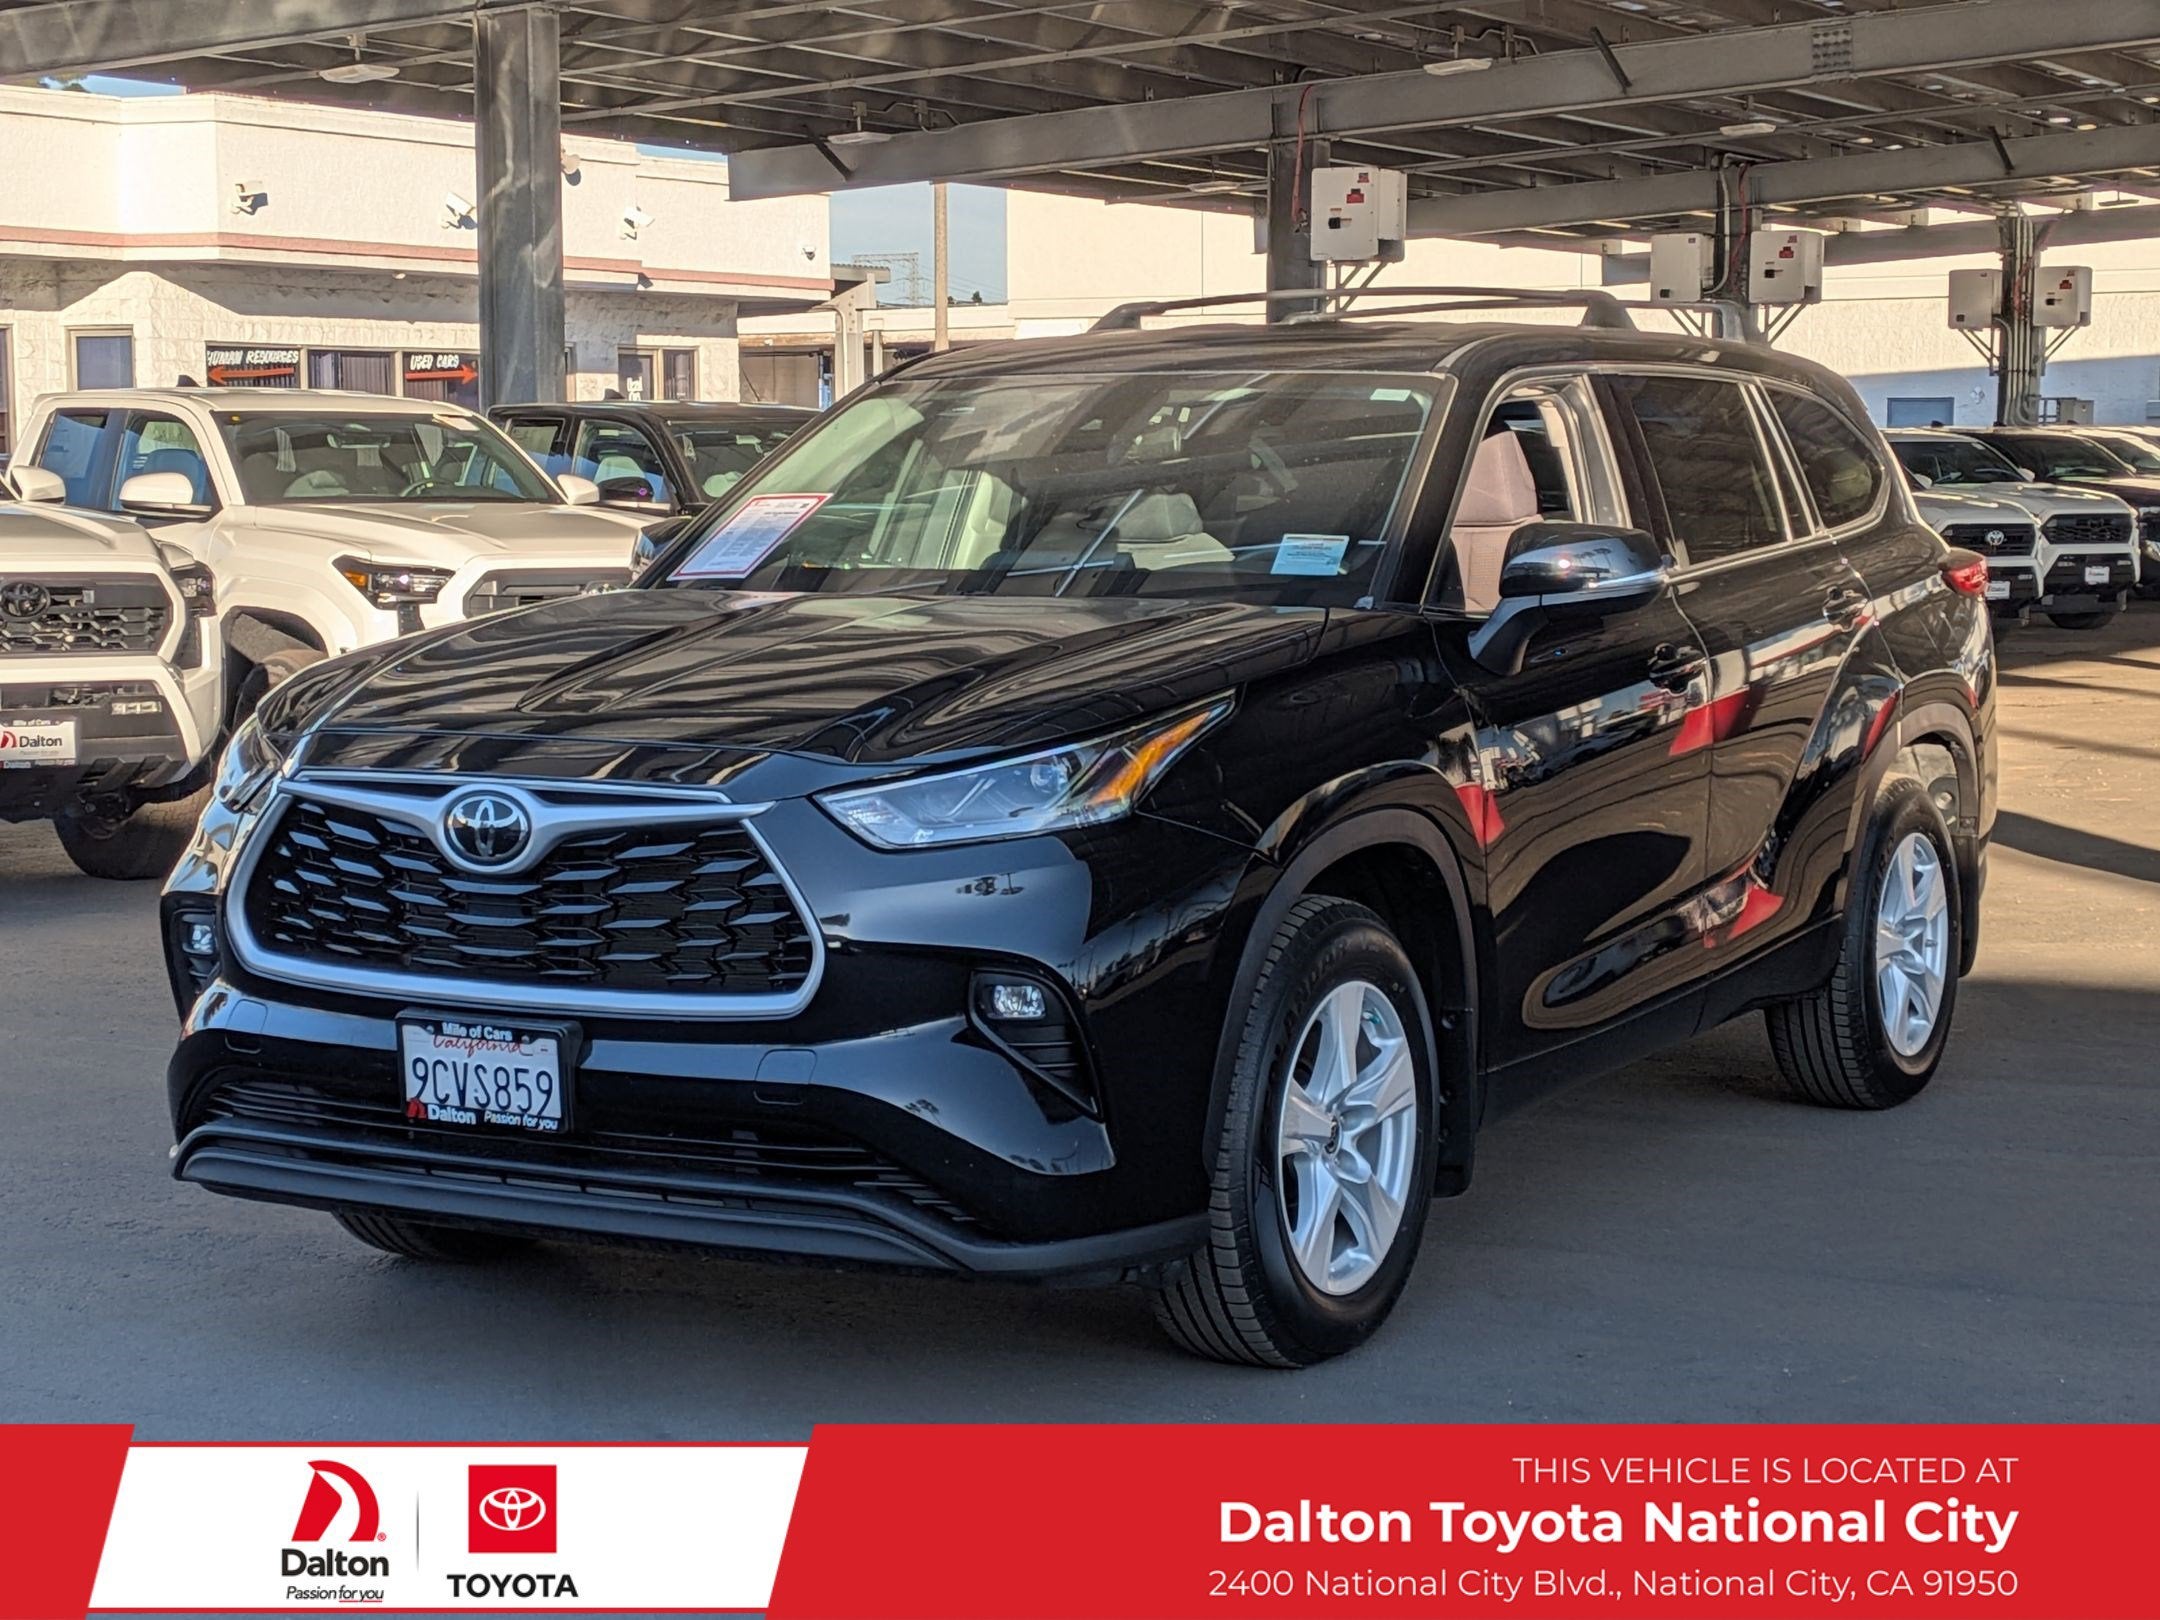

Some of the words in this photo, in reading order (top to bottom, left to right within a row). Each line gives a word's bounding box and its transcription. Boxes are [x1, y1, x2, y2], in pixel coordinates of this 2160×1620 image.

[246, 350, 299, 364] RESOURCES
[410, 354, 434, 370] USED
[436, 354, 460, 369] CARS
[19, 735, 63, 748] Dalton
[442, 1022, 468, 1037] Mile
[469, 1025, 482, 1038] of
[483, 1026, 513, 1042] Cars
[432, 1035, 534, 1057] California
[412, 1057, 553, 1117] 9CVS859
[427, 1104, 477, 1125] Dalton
[484, 1110, 521, 1126] Passion
[522, 1114, 538, 1127] for
[538, 1118, 558, 1131] you
